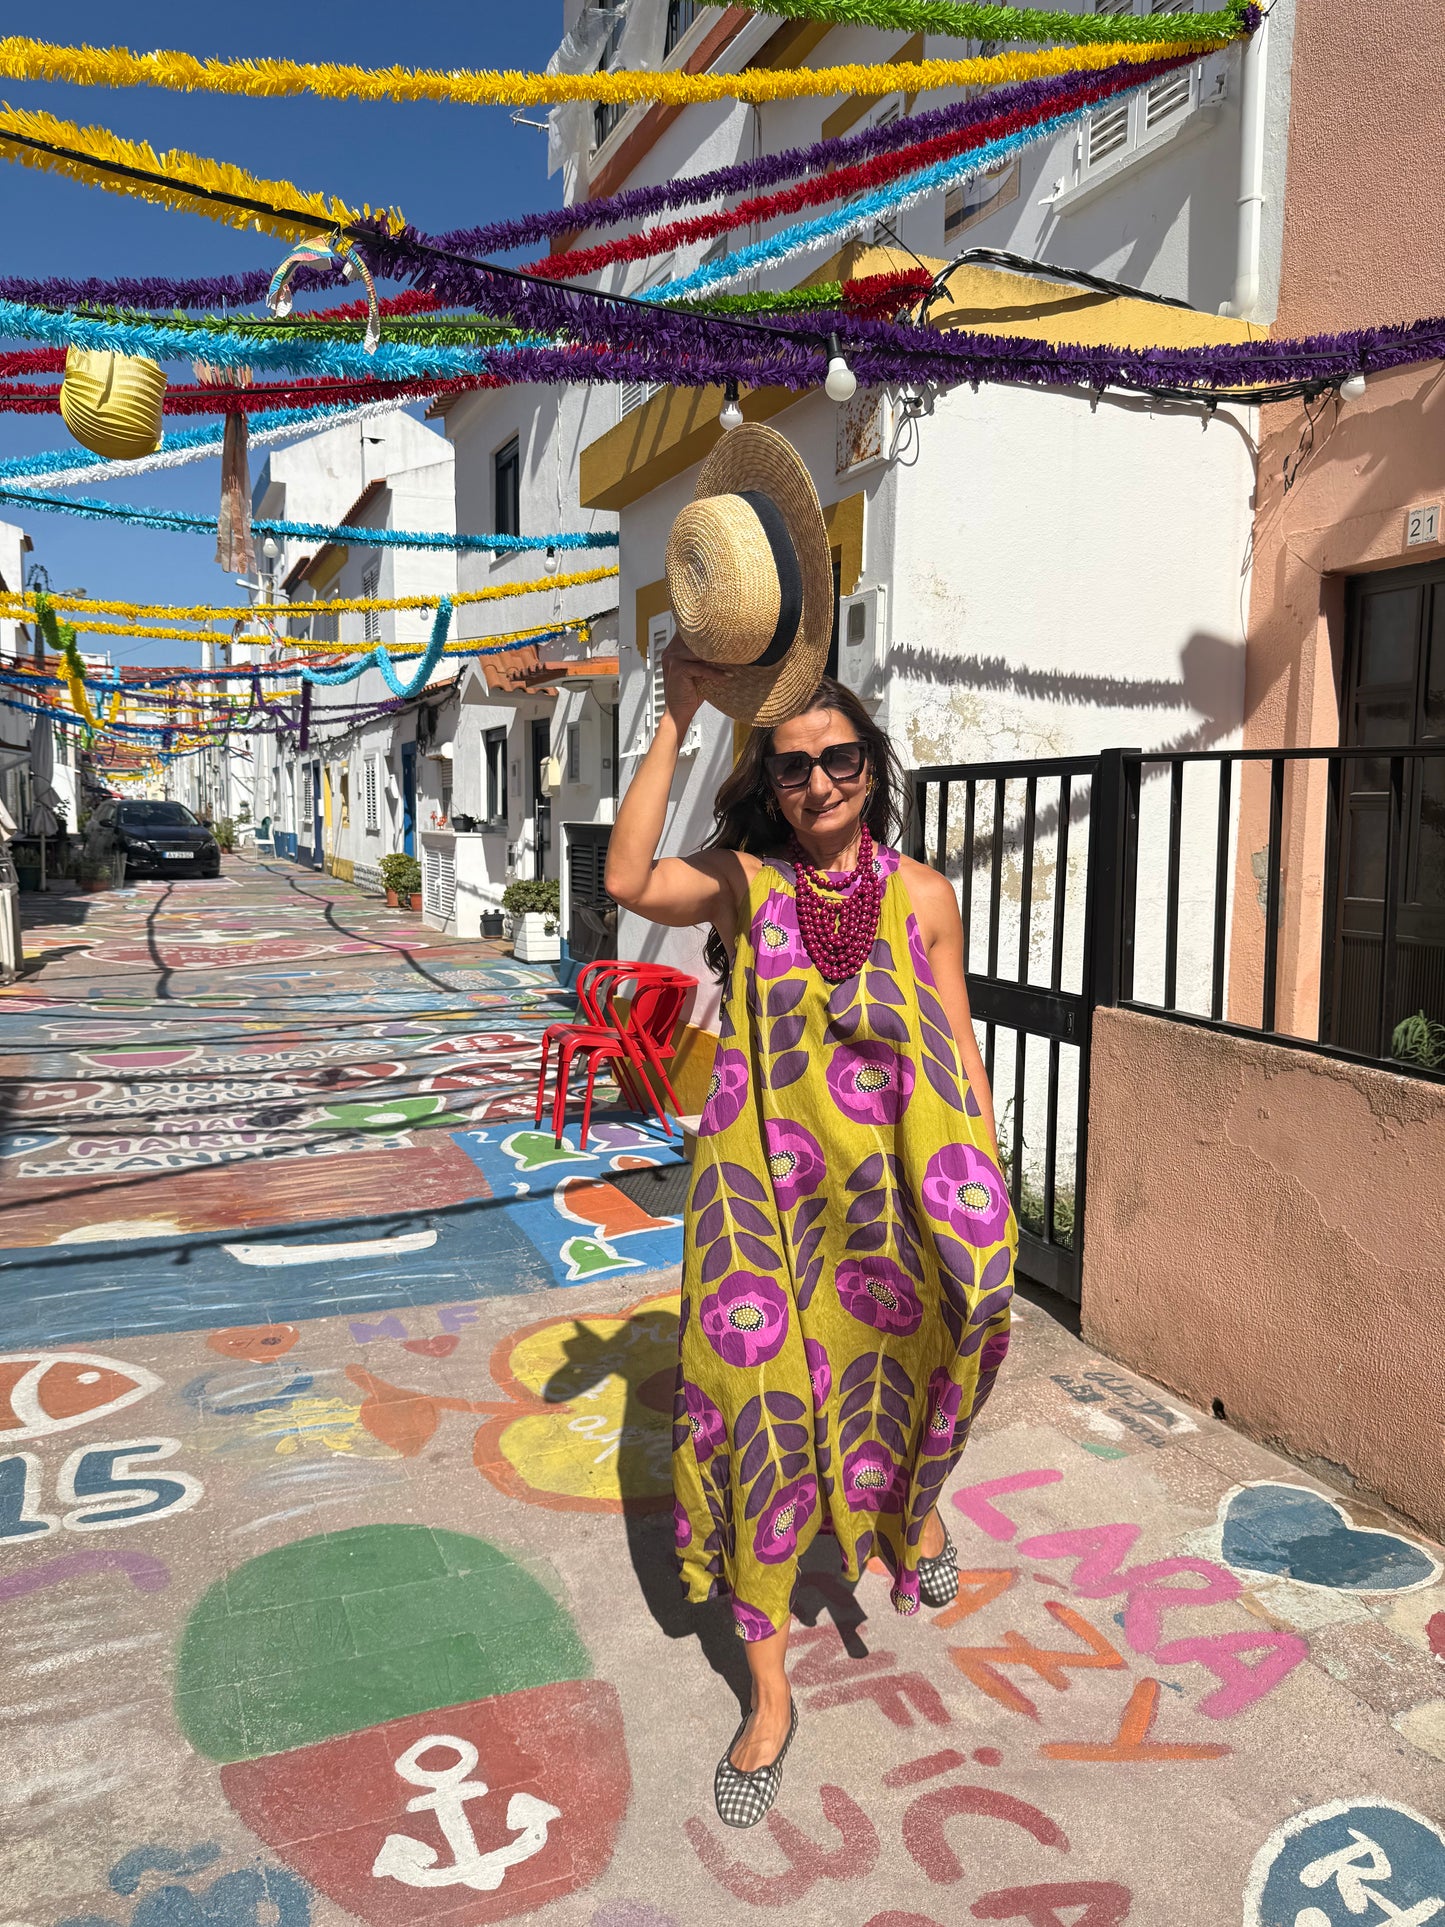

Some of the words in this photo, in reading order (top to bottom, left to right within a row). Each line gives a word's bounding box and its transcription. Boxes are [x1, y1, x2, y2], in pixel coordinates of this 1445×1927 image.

[1410, 514, 1434, 537] 21
[197, 1044, 393, 1064] TOMÁS
[77, 1060, 319, 1078] FRANCISCO
[87, 1088, 304, 1110] MANUEL
[122, 1081, 267, 1098] DINIS
[951, 1468, 1309, 1720] LARA
